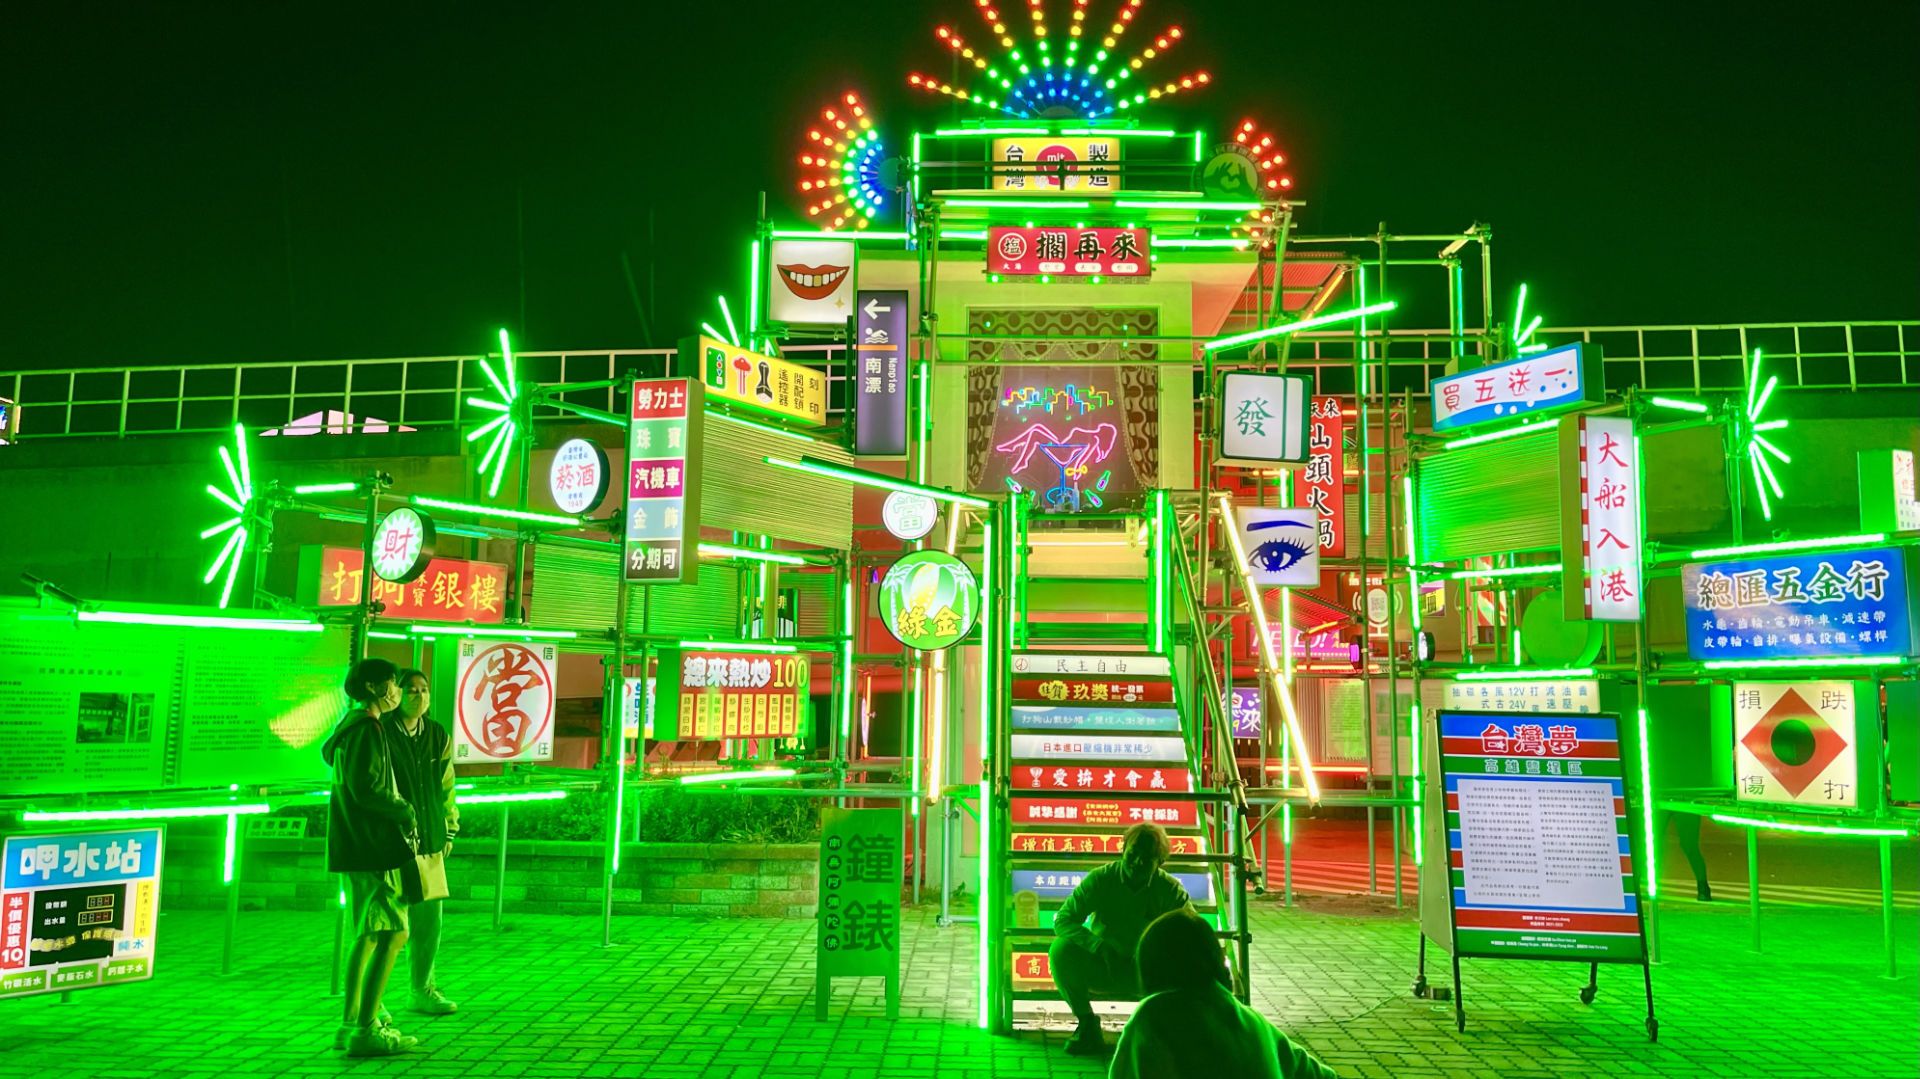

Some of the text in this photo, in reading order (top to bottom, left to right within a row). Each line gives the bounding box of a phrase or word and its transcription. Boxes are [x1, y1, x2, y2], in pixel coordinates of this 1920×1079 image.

[1036, 231, 1143, 261] 擱再來
[865, 357, 882, 393] 南漂
[888, 357, 898, 394] Nanpiao
[1443, 365, 1567, 411] 買五送一
[638, 387, 684, 410] 勞力士
[1235, 397, 1275, 437] 發
[636, 427, 681, 449] 珠寶
[634, 466, 680, 490] 汽機車
[1594, 432, 1634, 603] 大船入港
[631, 547, 677, 570] 分期可
[1698, 561, 1889, 612] 總匯五金行
[897, 604, 962, 640] 綠金
[773, 658, 808, 688] 100
[1056, 659, 1127, 673] 民主自由
[1509, 700, 1526, 709] 24V
[1481, 723, 1579, 756] 台灣夢
[1484, 758, 1582, 775] 高雄鹽埕區
[19, 839, 142, 881] 呷水站
[841, 833, 896, 951] 鐘錶
